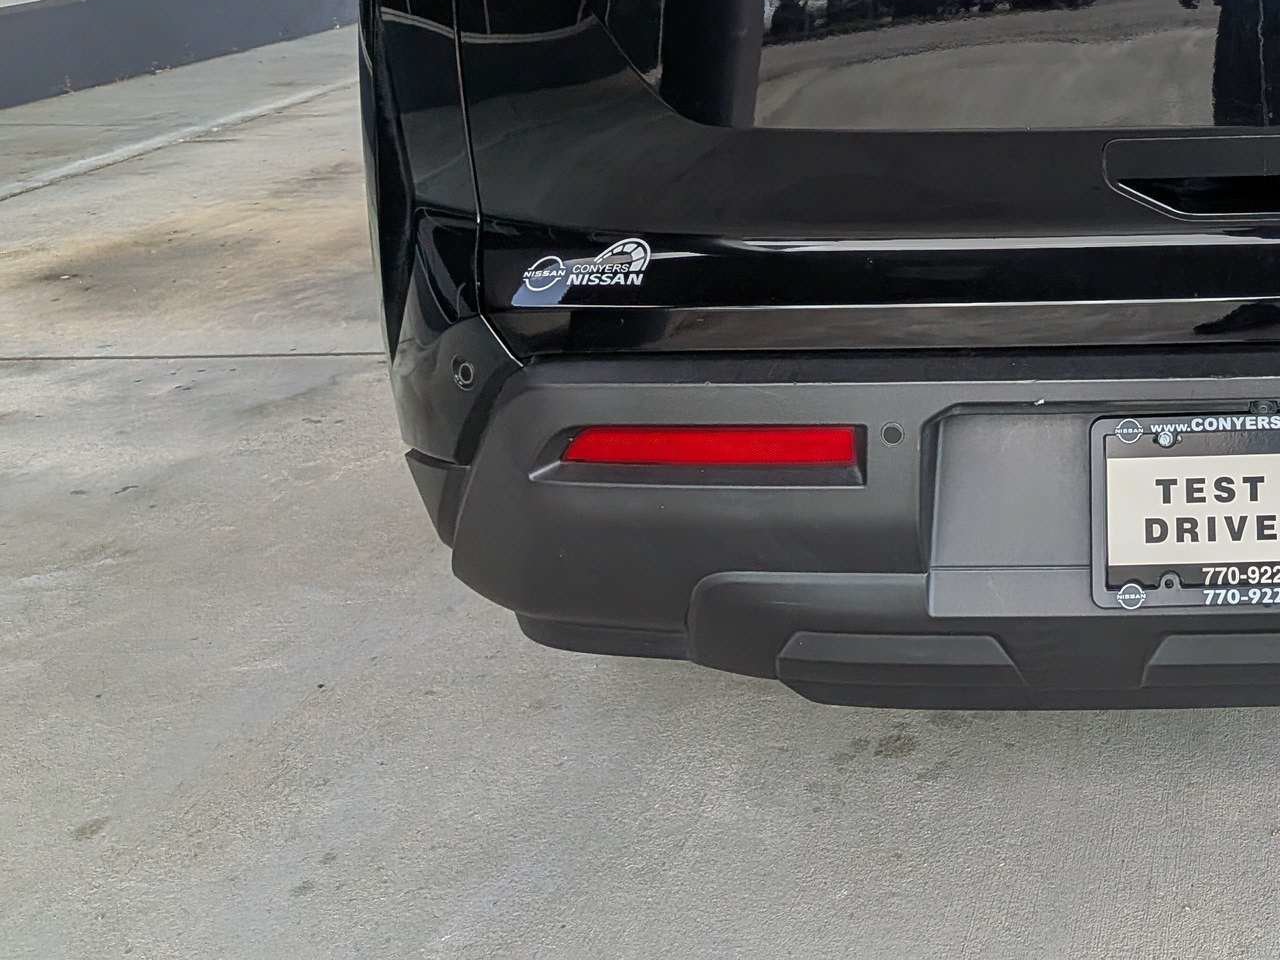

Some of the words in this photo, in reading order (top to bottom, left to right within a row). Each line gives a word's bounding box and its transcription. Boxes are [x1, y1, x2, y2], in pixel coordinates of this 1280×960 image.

[523, 270, 566, 278] NISSAN
[572, 264, 630, 273] CONYERS
[566, 273, 644, 286] NISSAN
[1154, 475, 1266, 505] TEST
[1144, 514, 1279, 544] DRIVE
